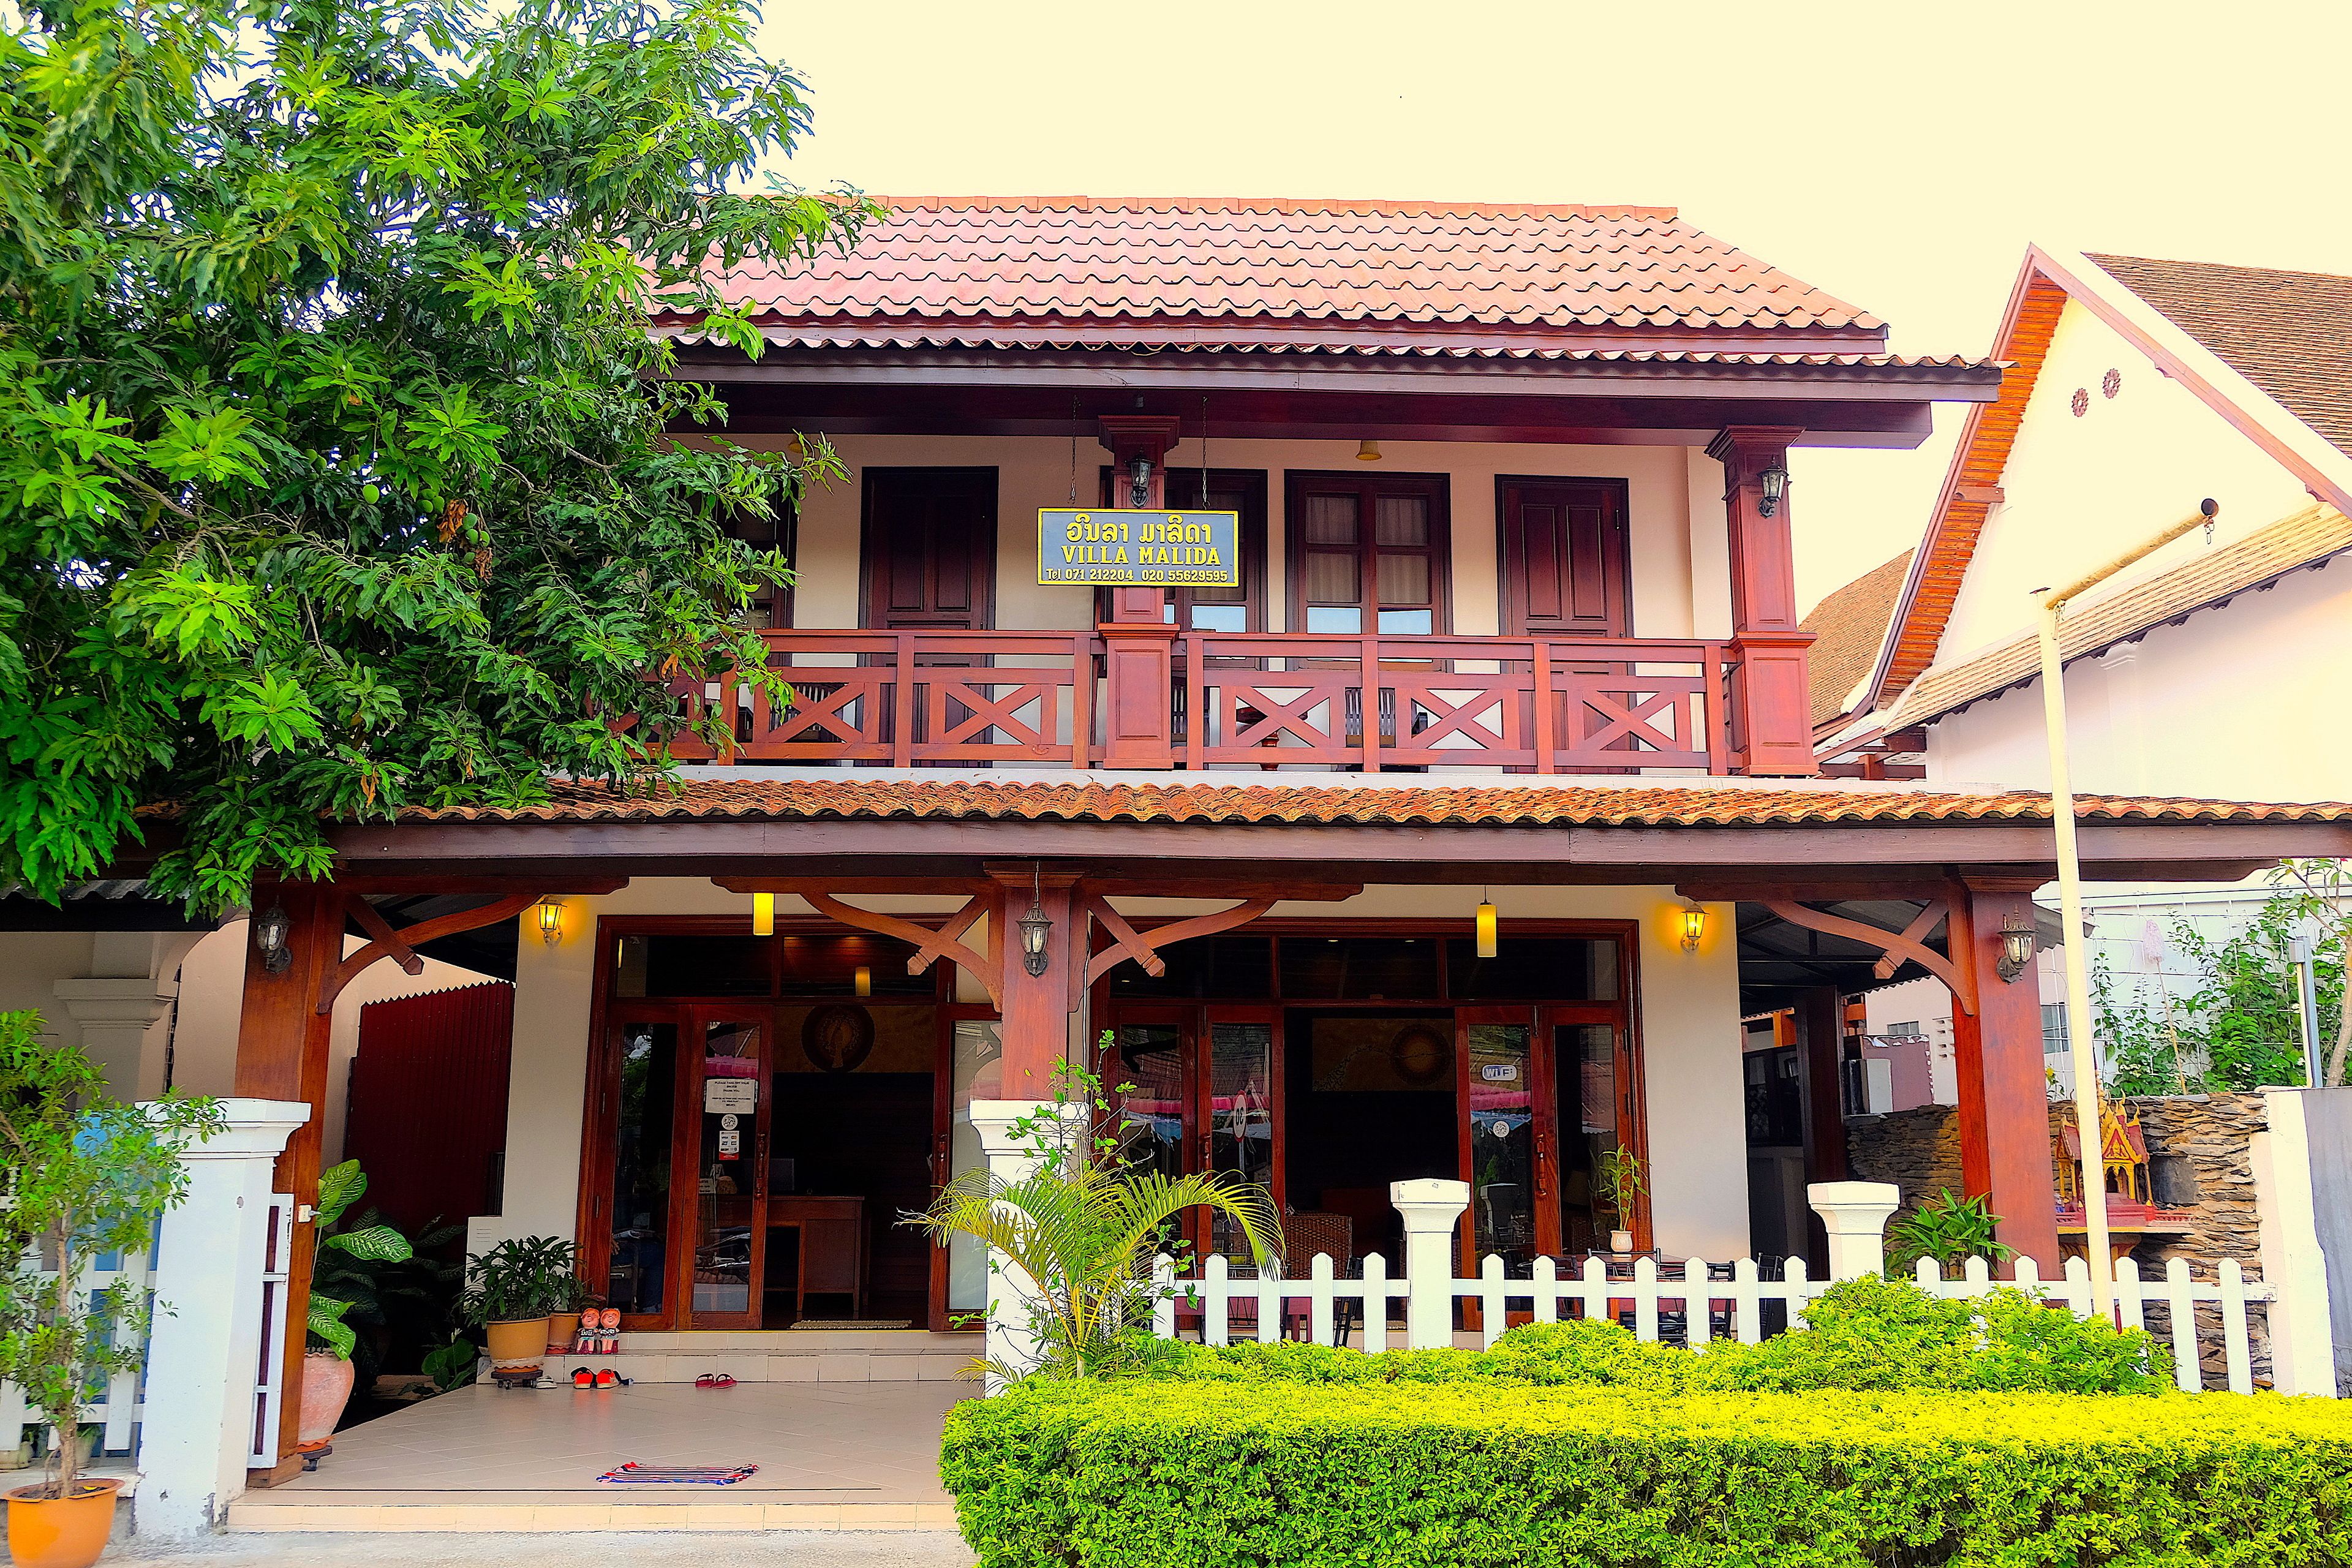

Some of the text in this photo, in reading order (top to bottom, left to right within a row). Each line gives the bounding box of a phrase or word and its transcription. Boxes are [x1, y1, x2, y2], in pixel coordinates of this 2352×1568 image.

[1066, 513, 1212, 543] ວິນລາ ມາລິດາ
[1061, 545, 1221, 565] VILLA MALIDA
[1046, 568, 1228, 581] Tel 071 212204 020 55629595
